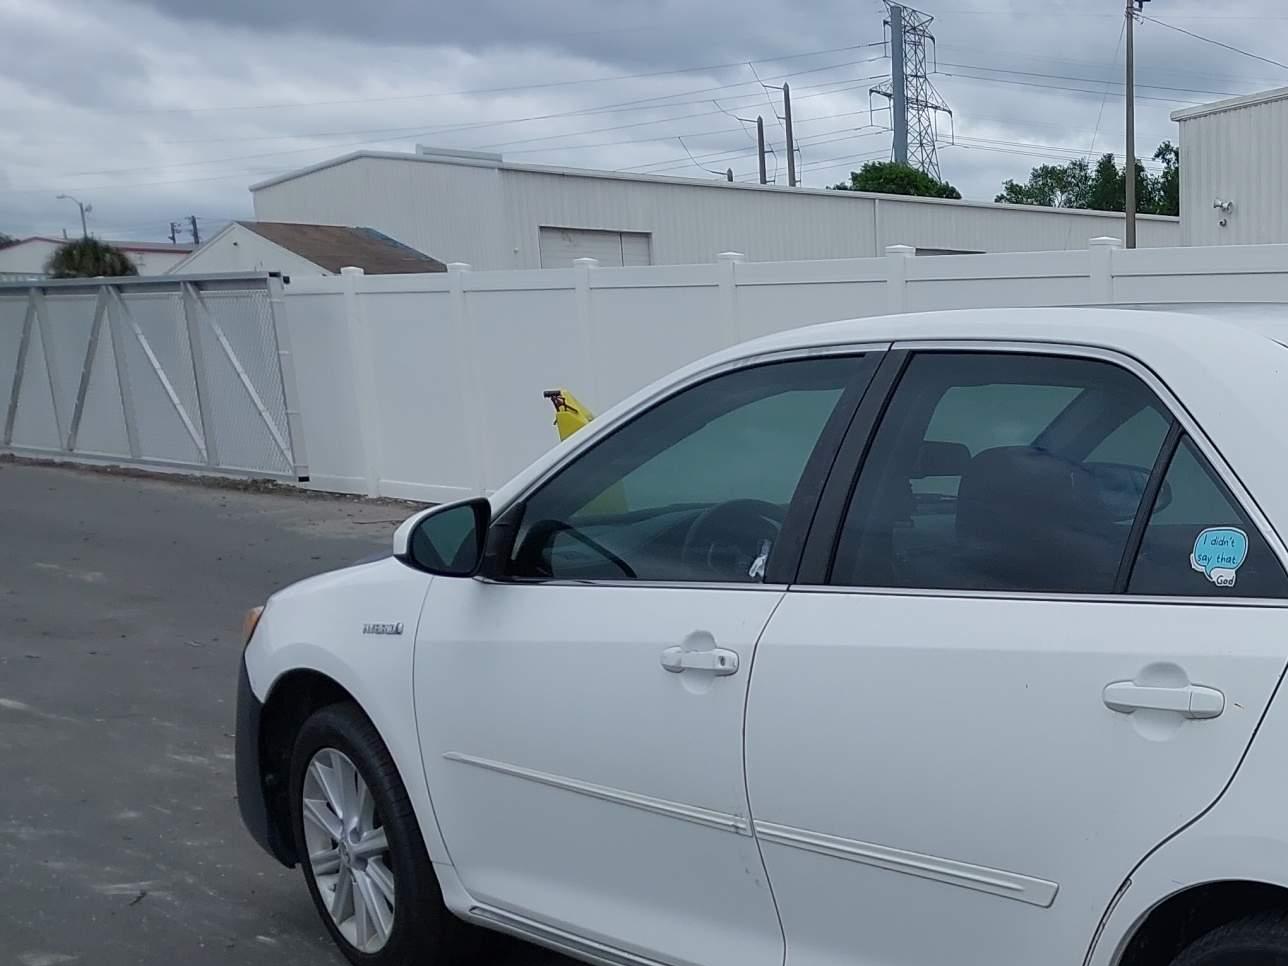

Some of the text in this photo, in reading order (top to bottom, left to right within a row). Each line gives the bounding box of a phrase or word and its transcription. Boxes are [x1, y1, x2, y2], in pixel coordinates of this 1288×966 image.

[1210, 536, 1235, 547] didn't
[1198, 554, 1212, 566] say
[1216, 575, 1235, 585] God
